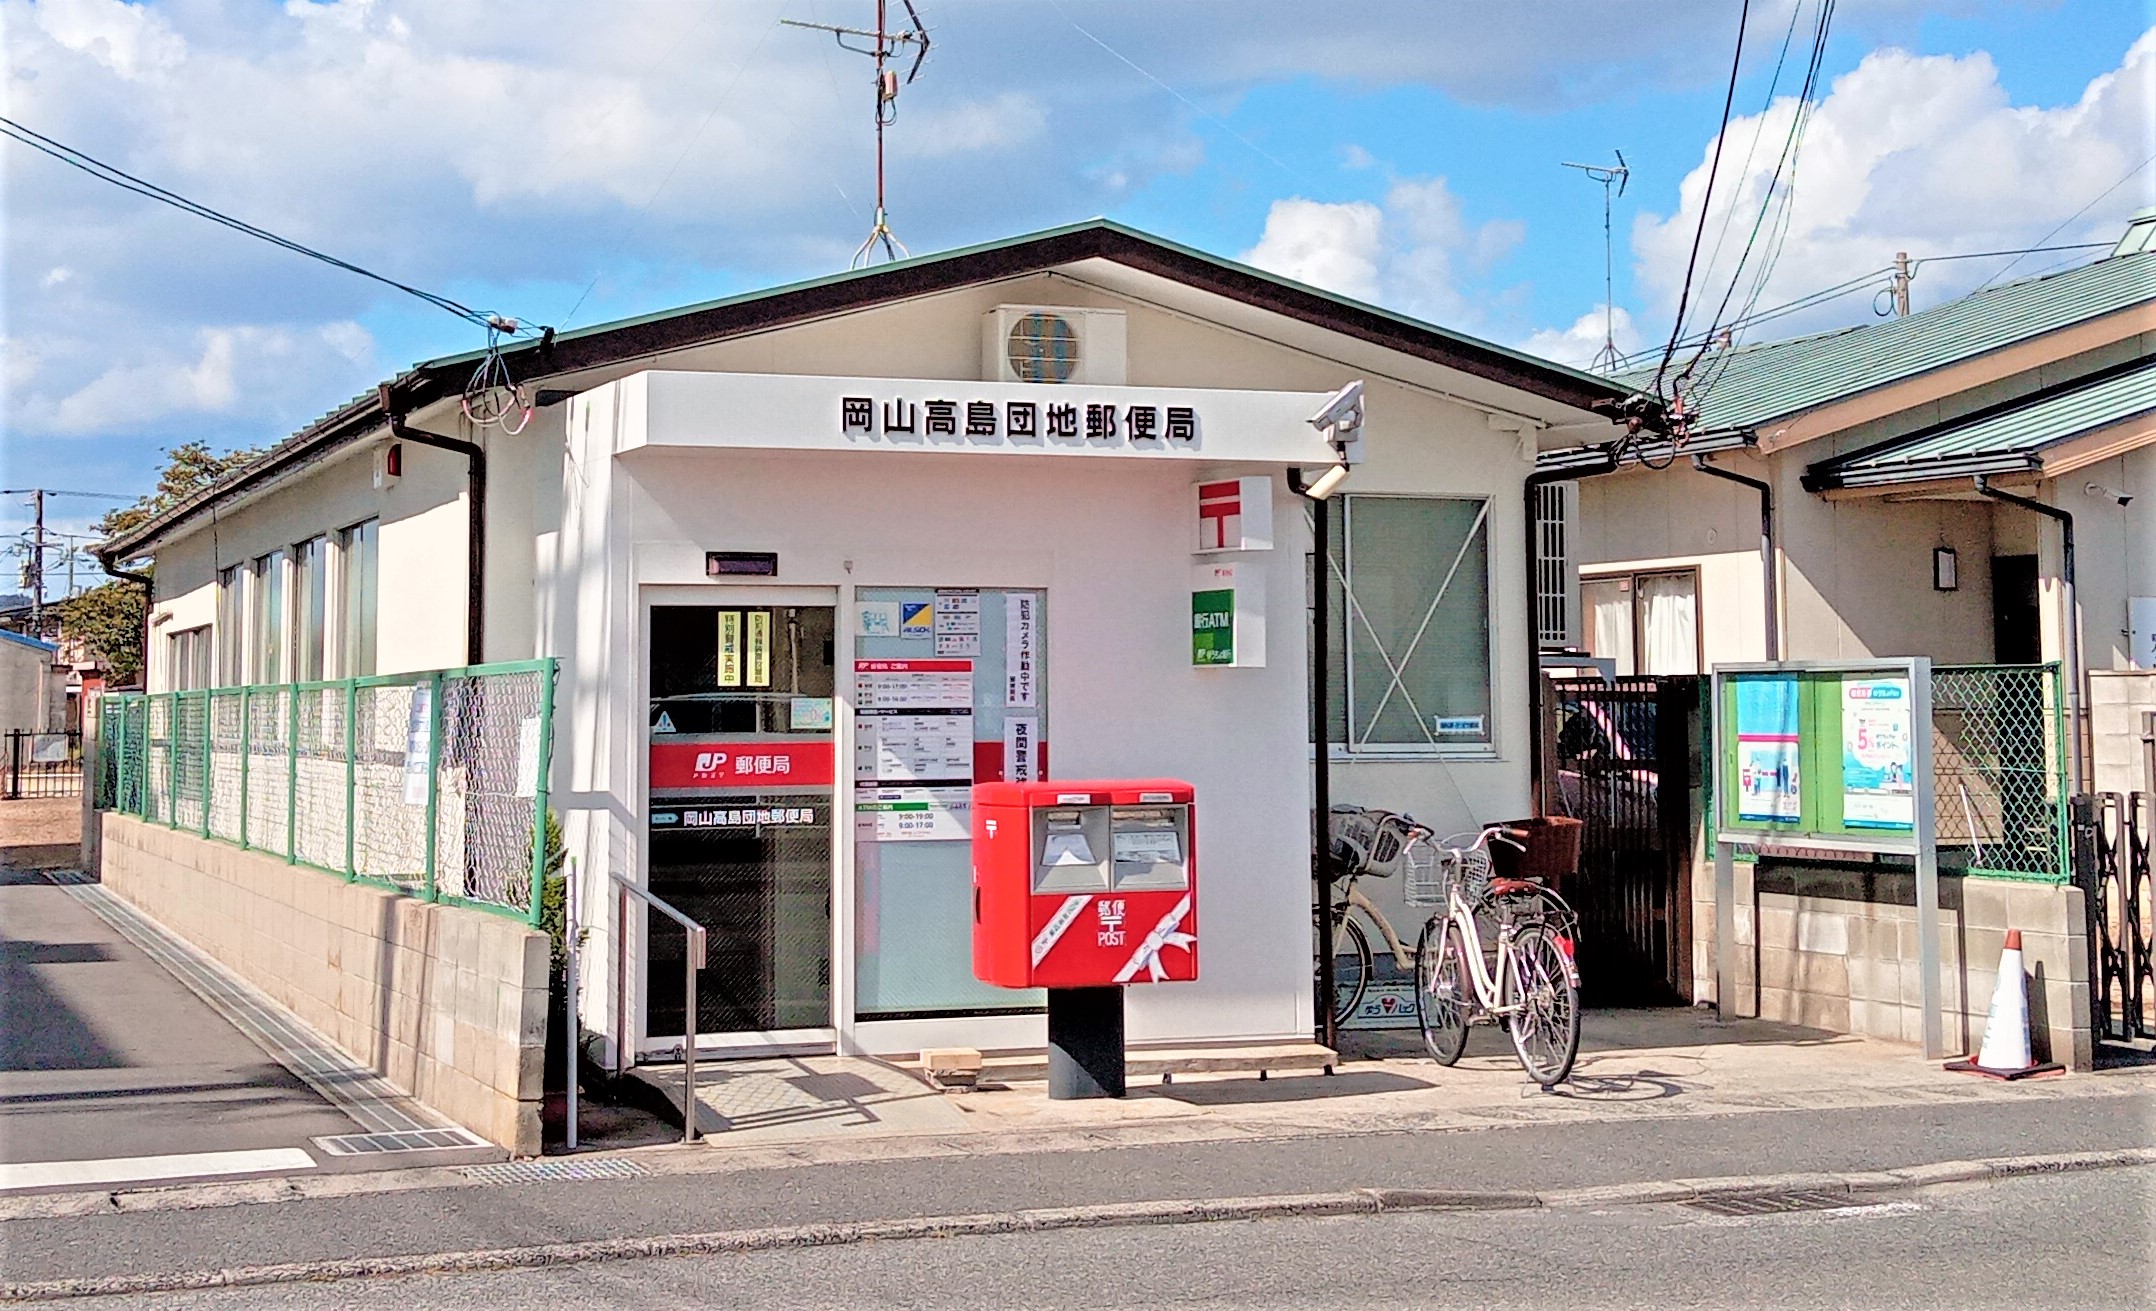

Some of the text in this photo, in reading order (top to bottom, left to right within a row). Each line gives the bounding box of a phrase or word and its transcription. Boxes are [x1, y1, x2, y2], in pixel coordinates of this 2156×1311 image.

[841, 396, 1196, 441] 岡山高島団地郵便局
[1021, 599, 1031, 701] 防犯カメラ作動中です
[735, 755, 790, 775] 郵便局
[683, 808, 814, 827] 岡山高島団地郵便局
[1097, 900, 1126, 917] 郵便
[1097, 931, 1126, 947] POST
